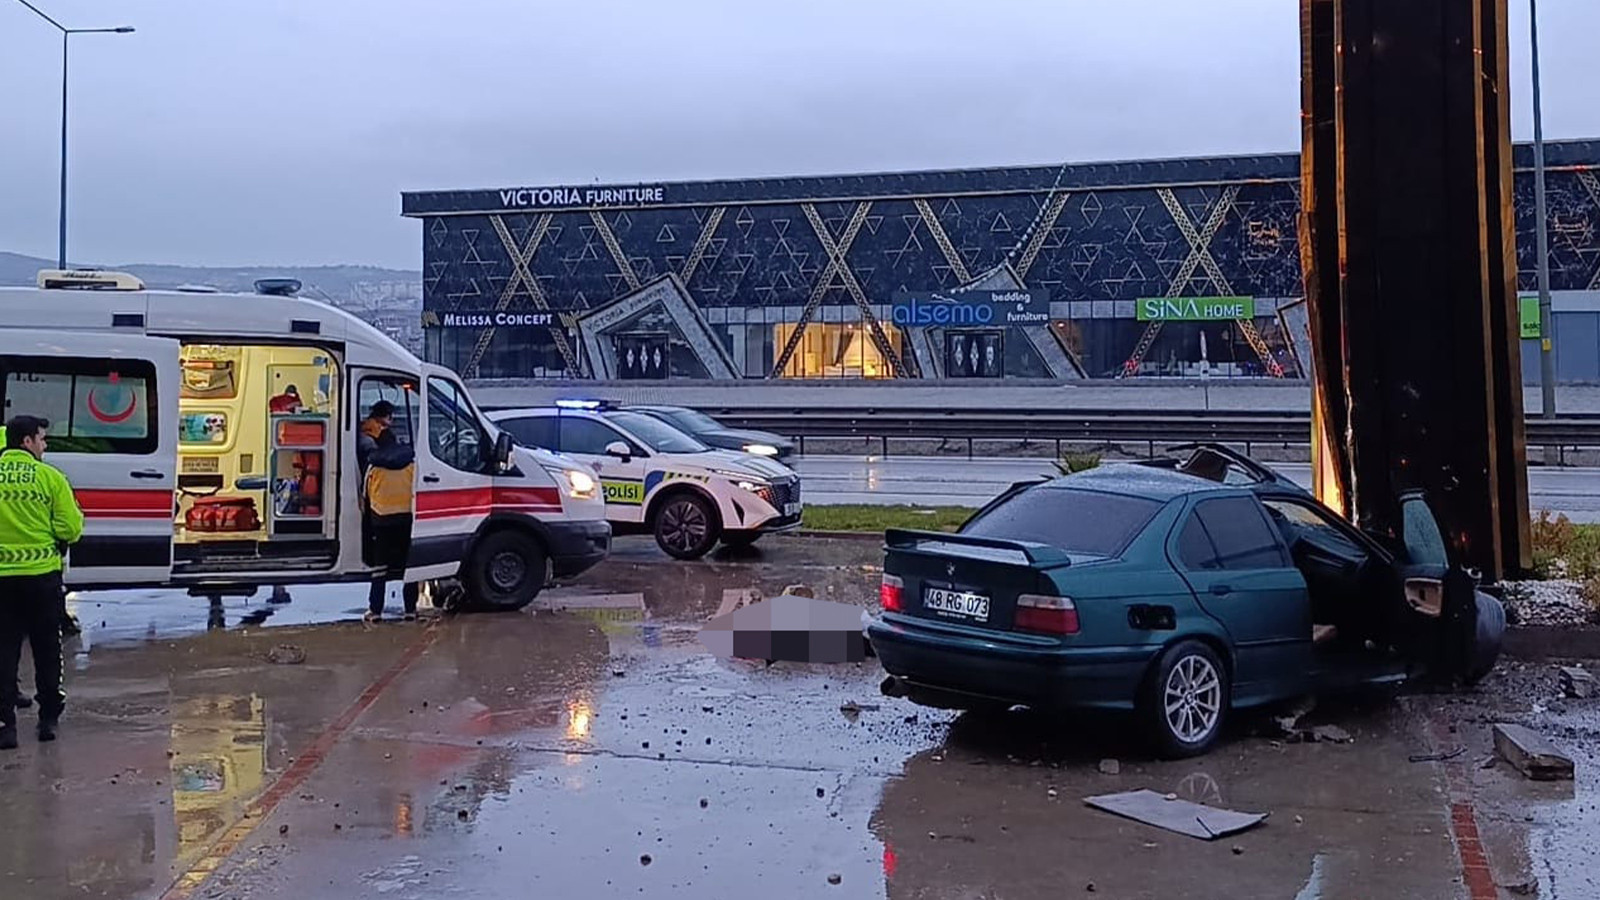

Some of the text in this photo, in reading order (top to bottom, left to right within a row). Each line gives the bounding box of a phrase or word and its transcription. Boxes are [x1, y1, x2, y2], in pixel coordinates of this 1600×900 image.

[499, 187, 664, 206] VICTORIA FURNITURE
[992, 292, 1031, 304] bedding
[892, 299, 993, 325] alsemo
[1007, 311, 1049, 323] furniture
[1204, 304, 1244, 318] HOME
[929, 590, 943, 607] 48
[946, 593, 963, 610] RG
[966, 597, 988, 615] 073
